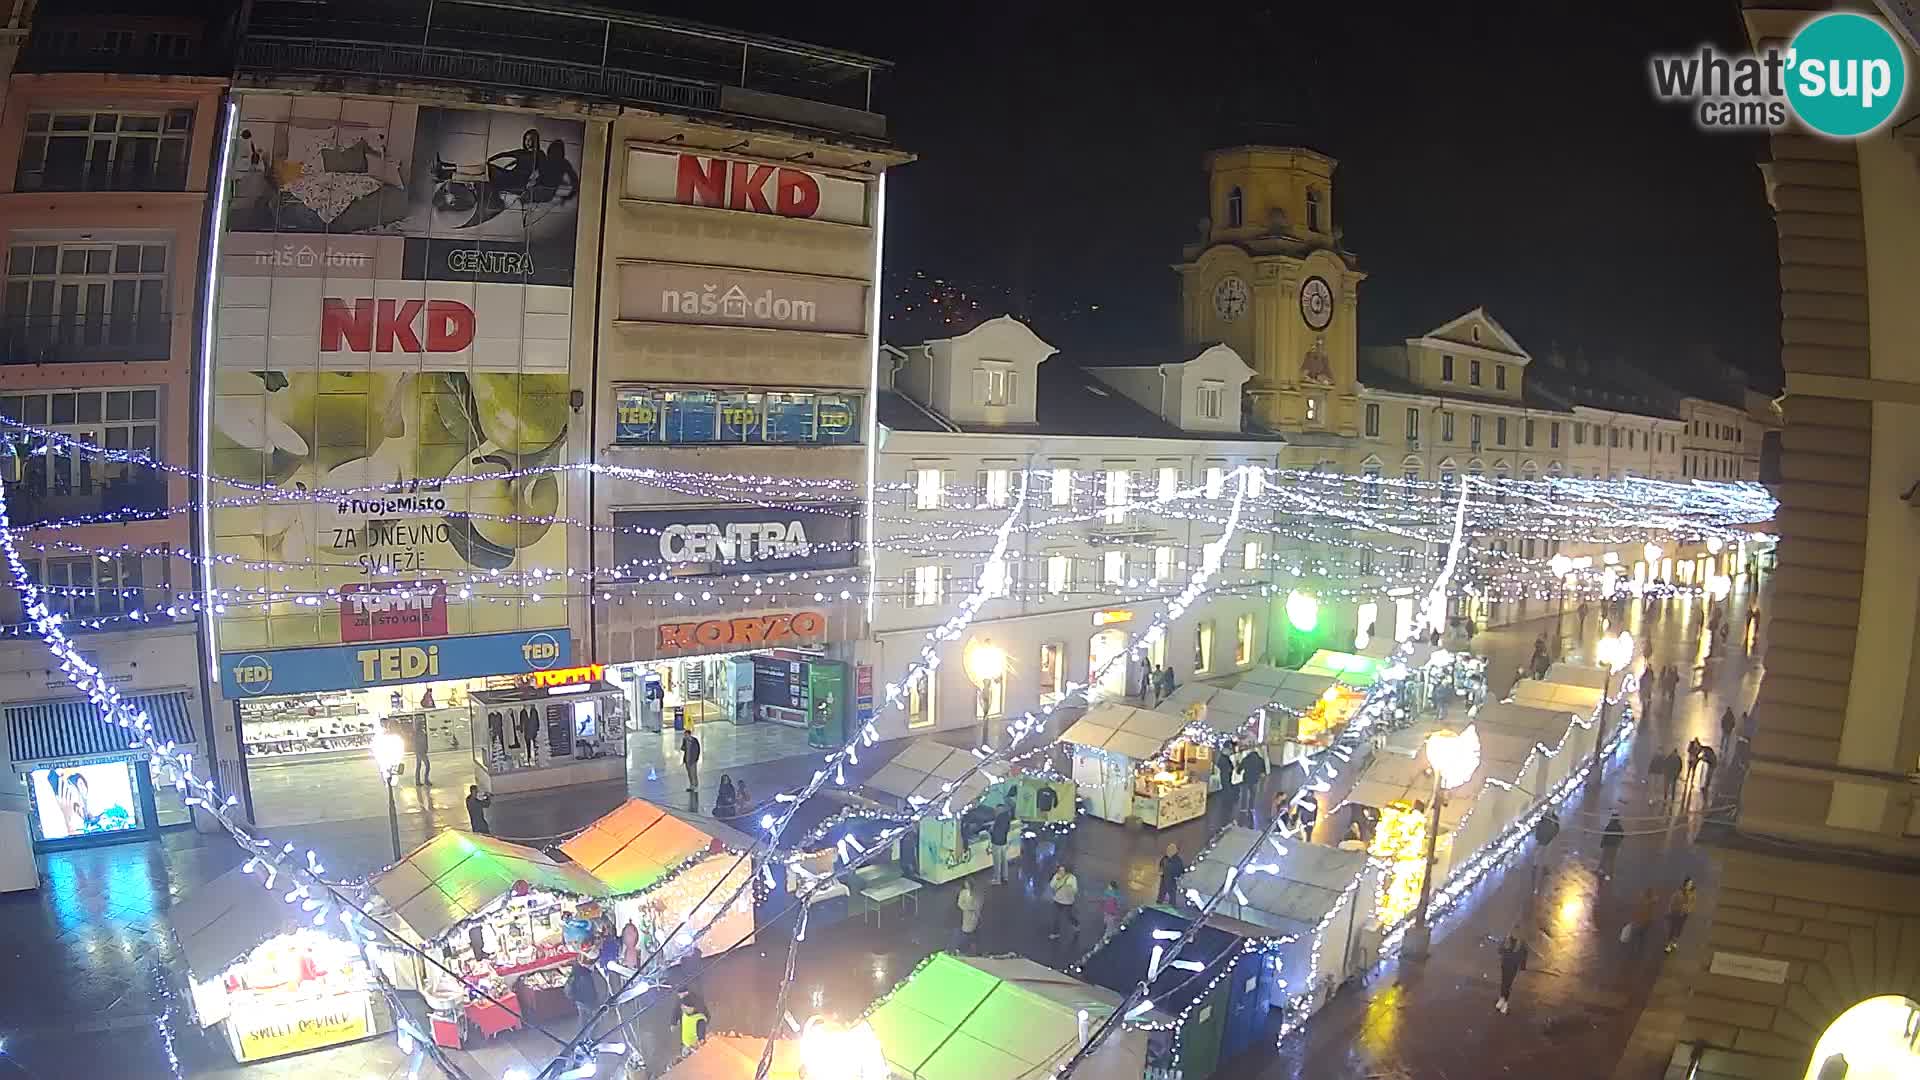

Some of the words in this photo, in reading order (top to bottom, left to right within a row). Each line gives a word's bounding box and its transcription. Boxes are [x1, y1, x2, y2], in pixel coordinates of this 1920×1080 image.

[676, 153, 820, 219] NKD
[447, 249, 535, 275] CENTRA
[661, 283, 717, 315] naš
[754, 289, 816, 322] dom
[320, 297, 477, 353] NKD
[338, 497, 446, 516] #TvojeMisto
[333, 528, 357, 548] ZA
[368, 523, 450, 547] DNEVNO
[659, 520, 810, 563] CENTRA
[359, 547, 425, 575] SVJEŽE
[657, 611, 826, 649] KORZO
[357, 645, 439, 682] TEDi
[522, 639, 560, 660] TEDi
[233, 664, 272, 684] TEDi
